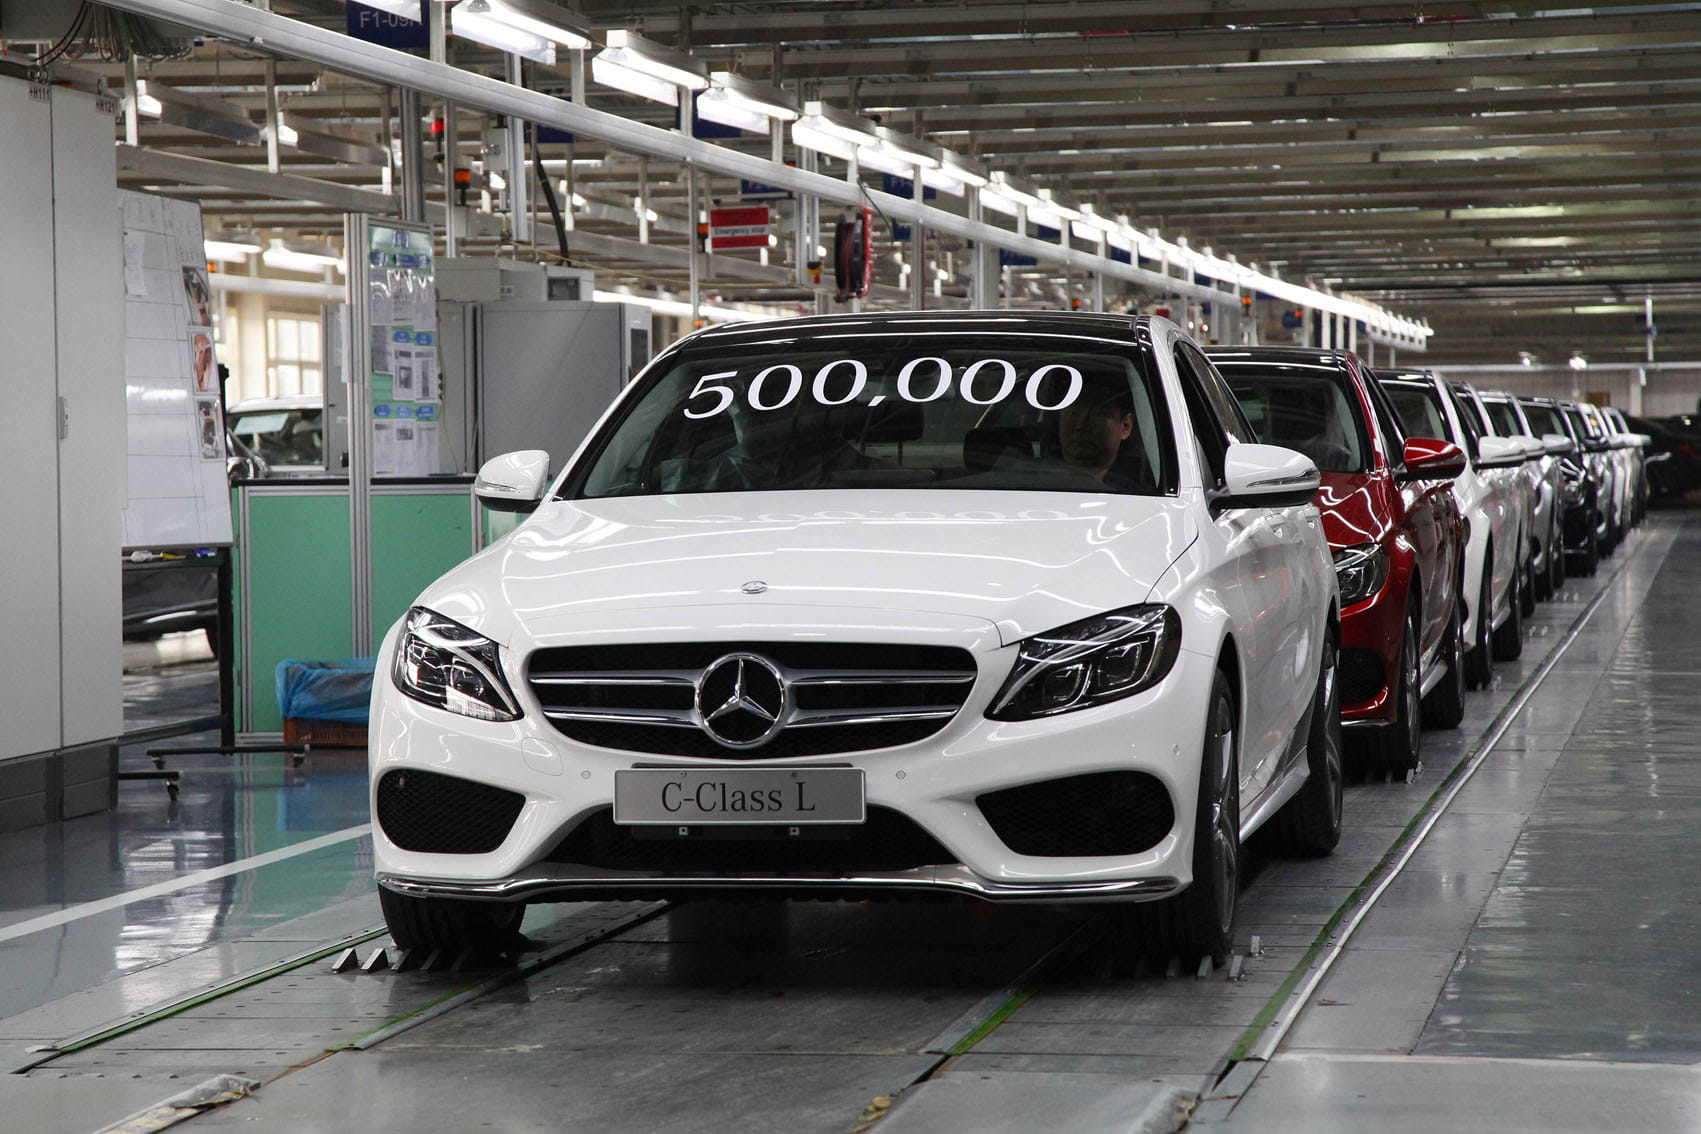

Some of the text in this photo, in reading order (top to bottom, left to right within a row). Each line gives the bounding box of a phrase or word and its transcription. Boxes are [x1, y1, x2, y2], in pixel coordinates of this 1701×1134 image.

[714, 227, 750, 237] Emergency
[683, 356, 1083, 420] 500,000
[661, 781, 817, 813] C-Class L
